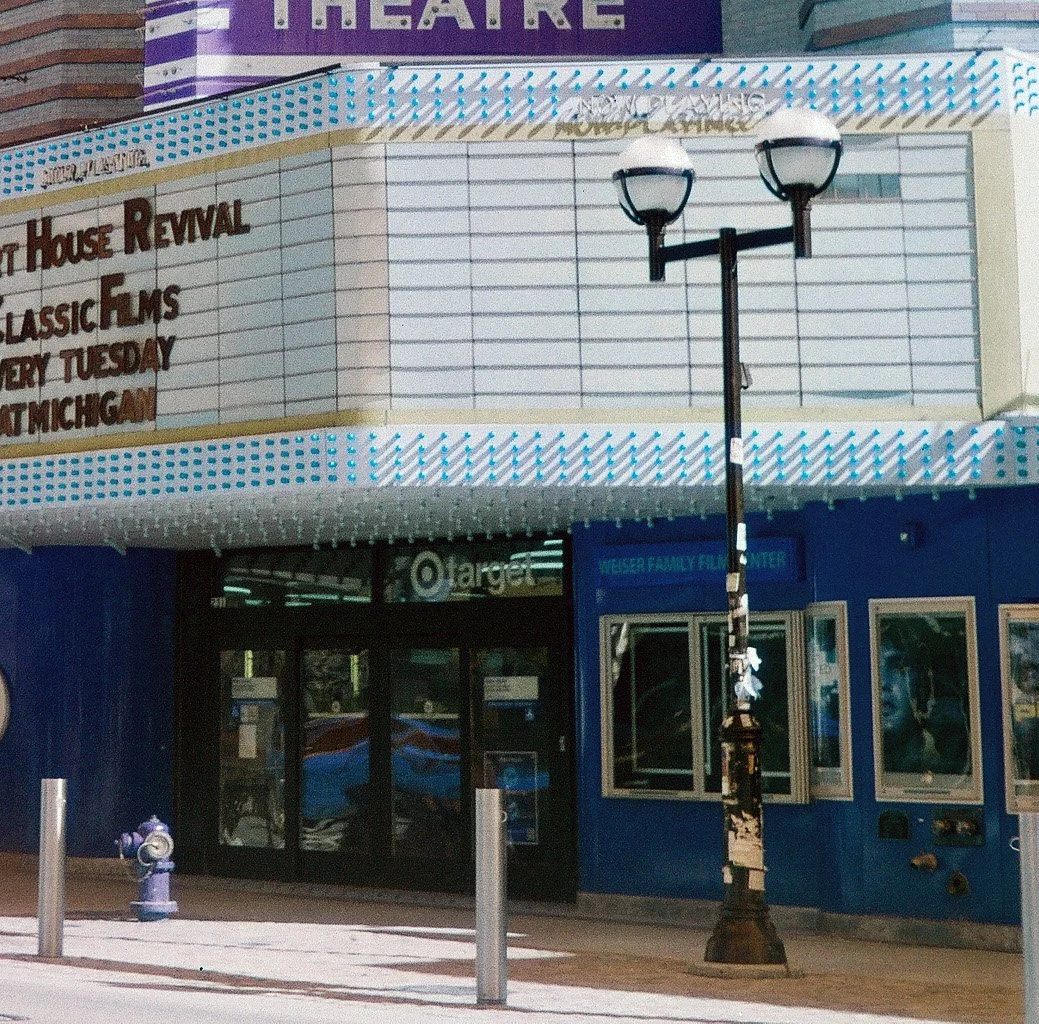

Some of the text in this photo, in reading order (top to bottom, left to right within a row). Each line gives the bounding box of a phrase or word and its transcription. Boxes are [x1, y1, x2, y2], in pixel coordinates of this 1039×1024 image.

[26, 215, 114, 273] HOUSE
[124, 197, 251, 255] REVIVAL
[100, 272, 181, 331] FILMS
[60, 335, 176, 384] TUESDAY
[28, 386, 157, 435] MICHIGAN
[444, 552, 536, 596] target
[599, 556, 645, 575] WEISER
[647, 554, 695, 573] FAMILY
[736, 550, 786, 570] NTER
